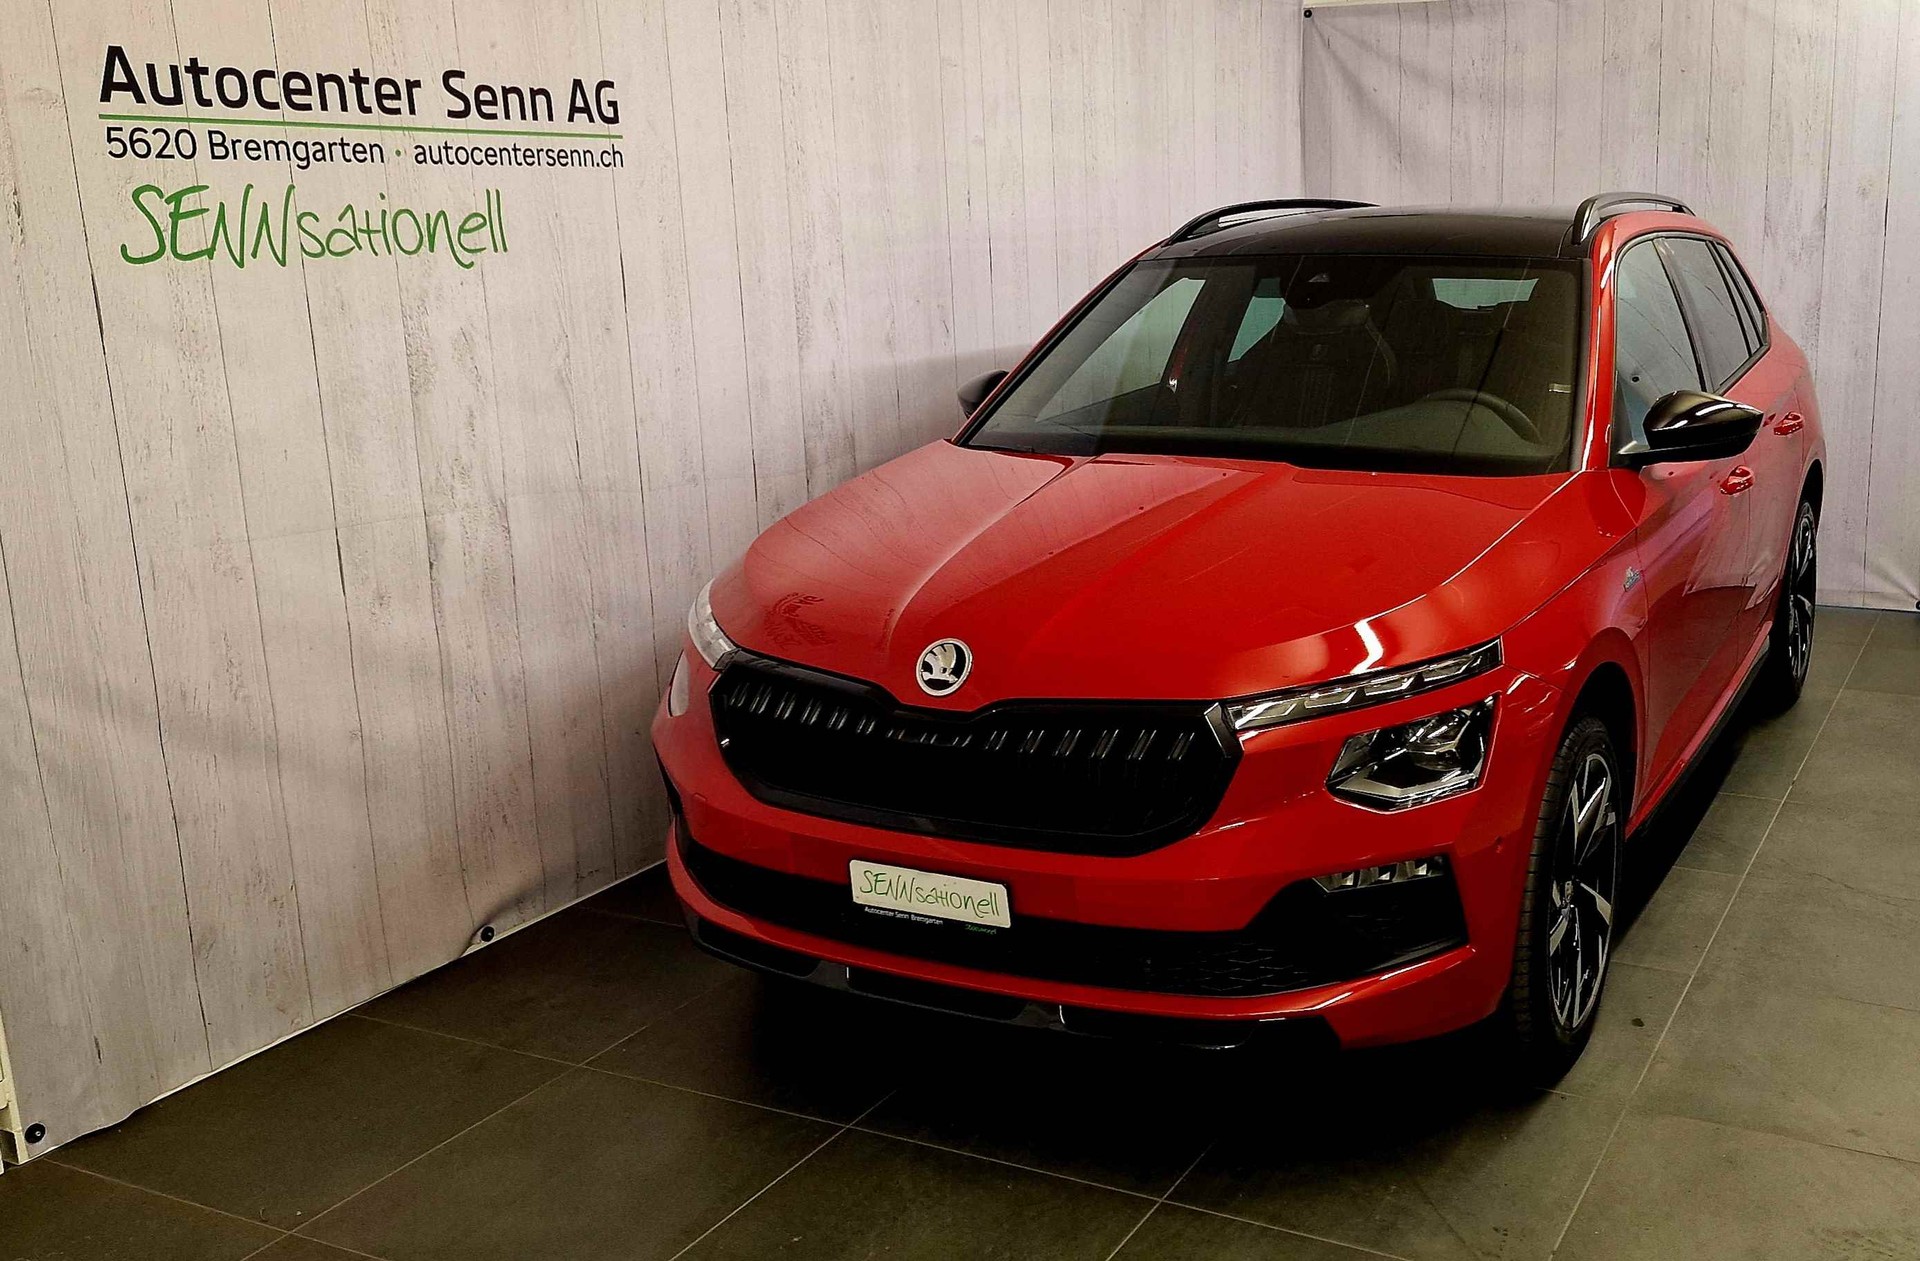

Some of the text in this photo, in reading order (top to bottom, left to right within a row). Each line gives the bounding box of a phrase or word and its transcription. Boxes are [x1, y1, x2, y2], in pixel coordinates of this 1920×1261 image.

[99, 45, 620, 125] Autocenter Senn AG
[105, 126, 624, 170] 5620 Bremgarten autocentersenn.ch
[120, 183, 508, 269] SENNsationell
[859, 869, 1000, 918] SENNsationell
